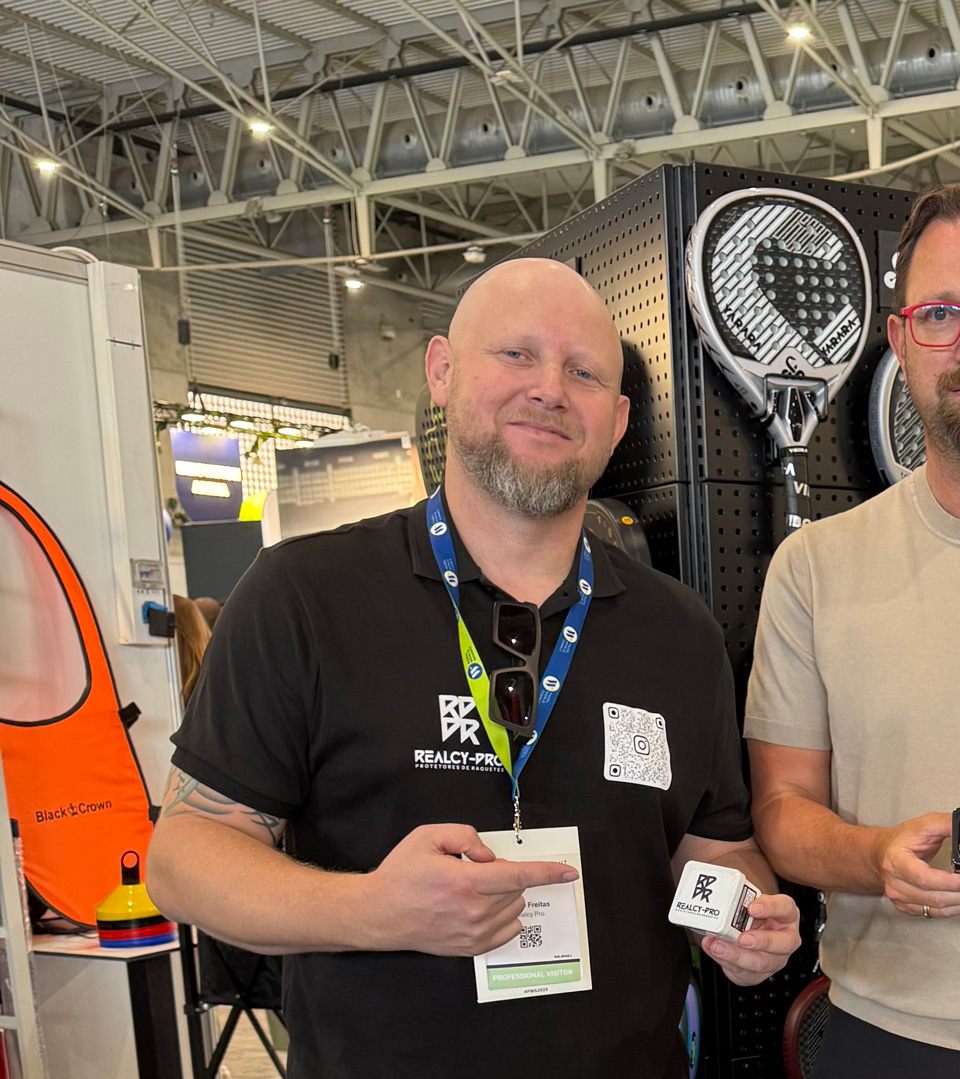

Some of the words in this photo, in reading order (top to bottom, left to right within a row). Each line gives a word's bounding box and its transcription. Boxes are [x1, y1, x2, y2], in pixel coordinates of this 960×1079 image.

[721, 302, 762, 353] YARARA
[414, 749, 503, 767] REALCY-PRO
[415, 763, 460, 771] PROTETORES
[35, 808, 68, 823] Black
[78, 800, 112, 815] Crown
[527, 900, 551, 908] Freitas
[676, 901, 720, 917] REALCY-PRO
[492, 970, 545, 982] PROFESSIONAL
[546, 968, 574, 978] VISITOR
